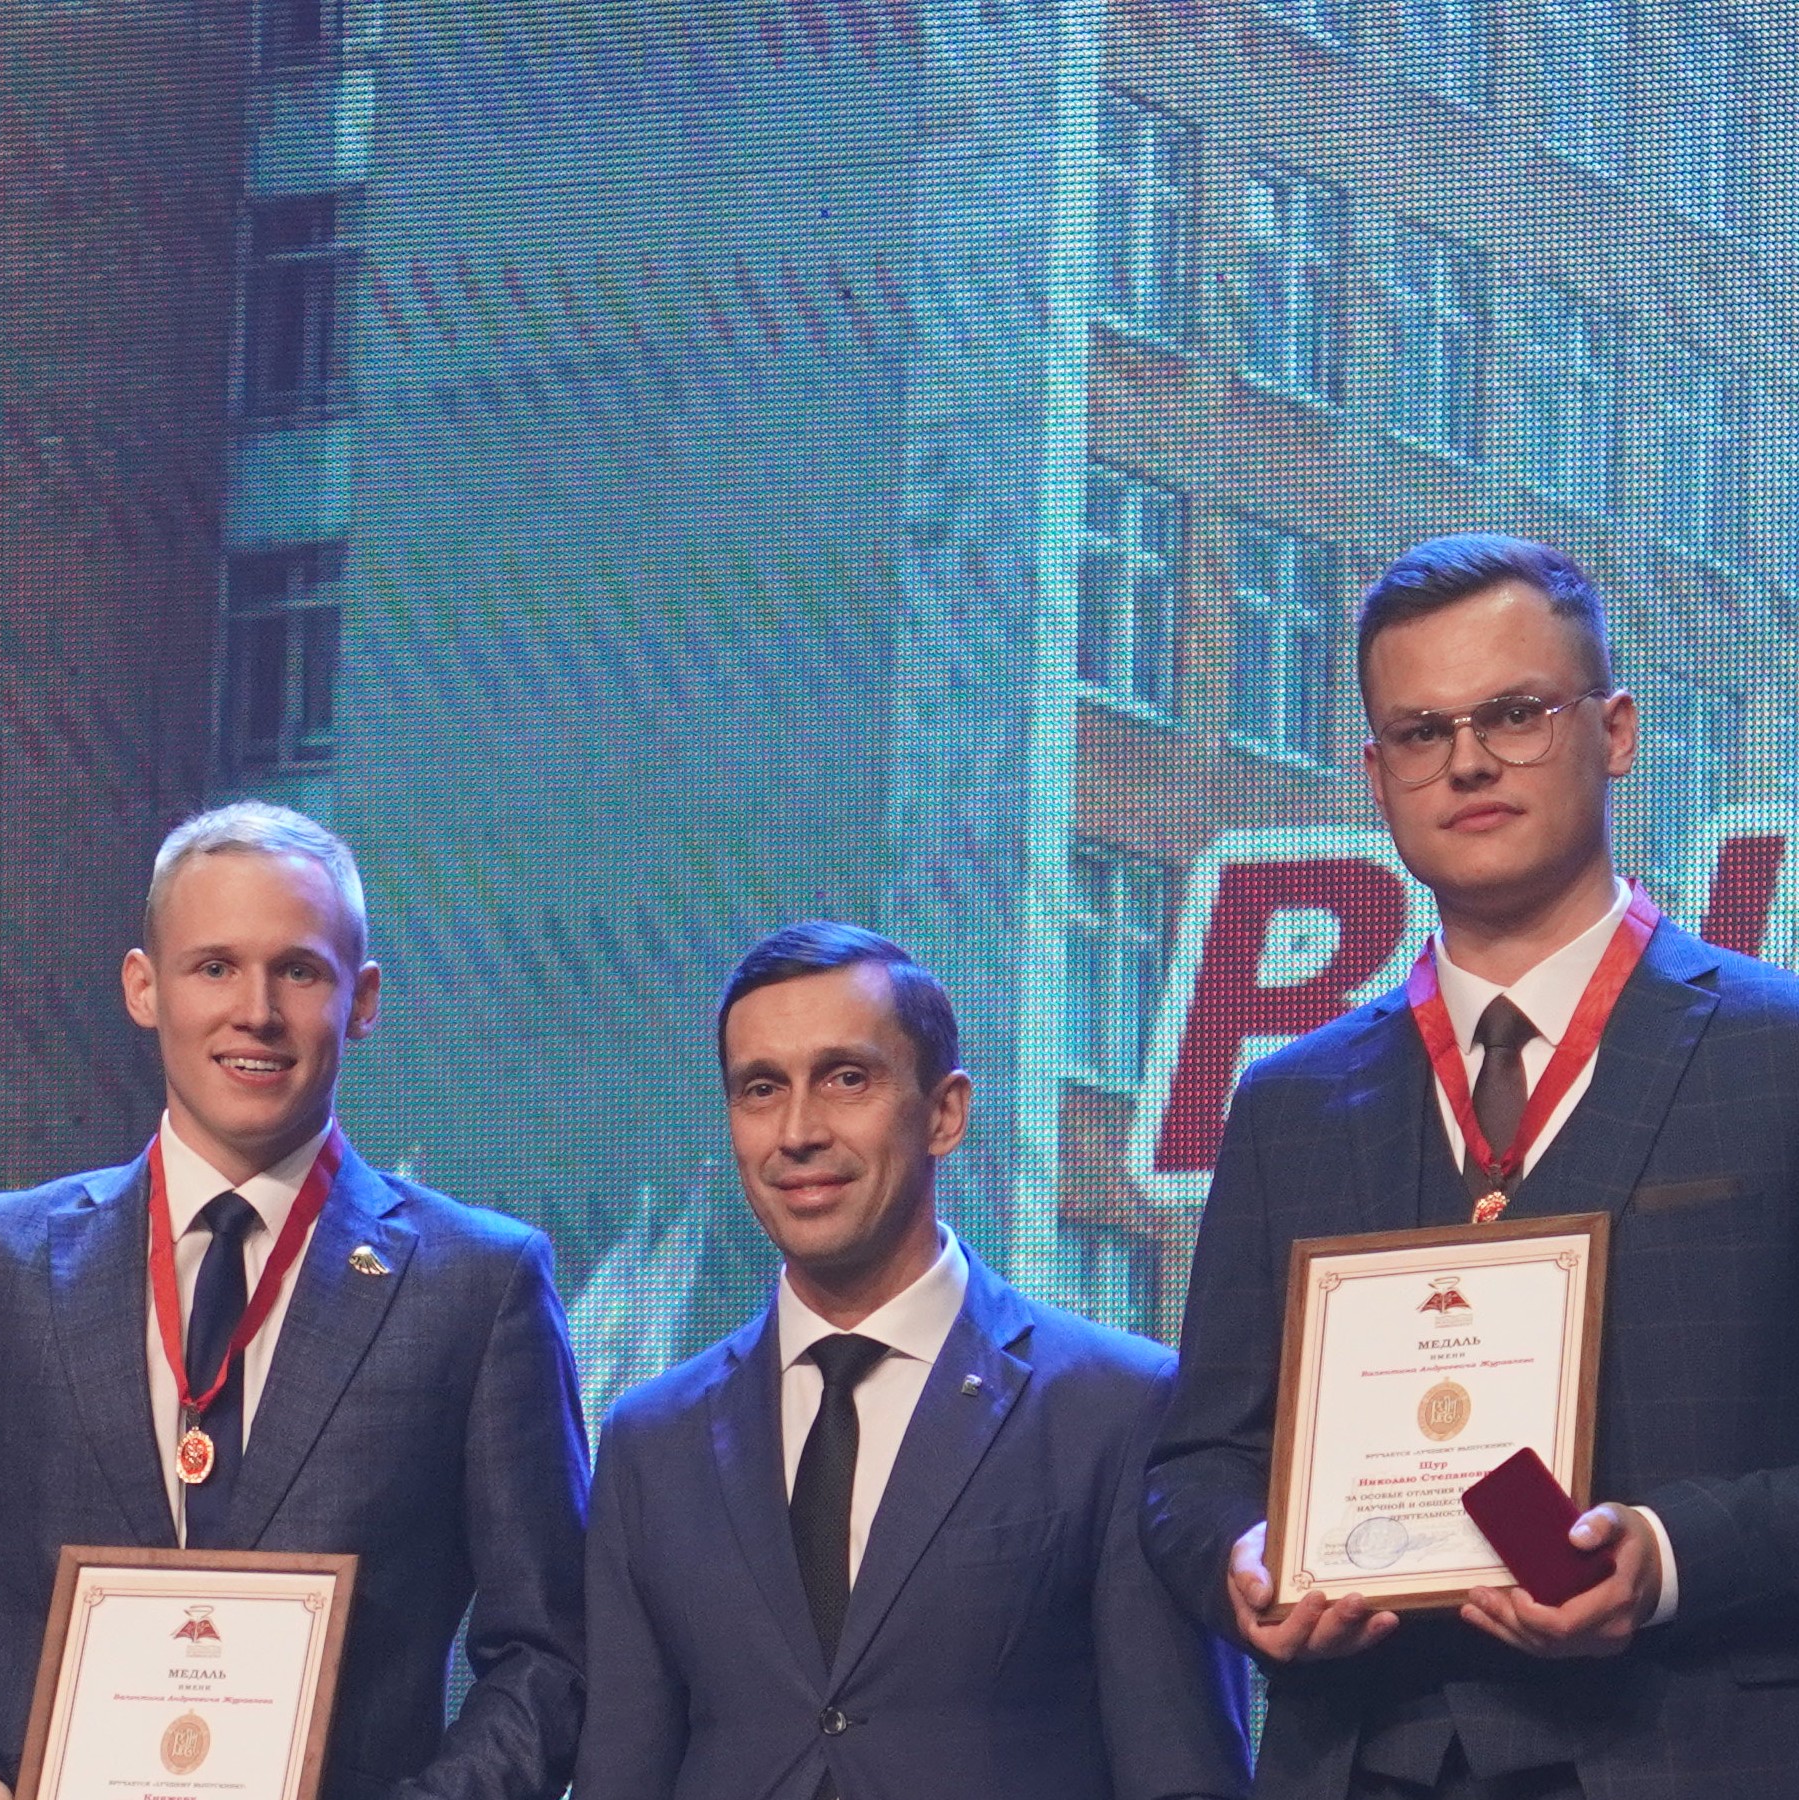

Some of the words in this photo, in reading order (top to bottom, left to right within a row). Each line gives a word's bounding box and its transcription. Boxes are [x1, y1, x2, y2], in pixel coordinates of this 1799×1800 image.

[1418, 1336, 1481, 1350] МЕДАЛЬ
[1418, 1461, 1448, 1471] Щур
[1359, 1476, 1417, 1487] Николаю
[1345, 1495, 1357, 1503] ЗА
[1360, 1491, 1403, 1501] ОСОБЫЕ
[1406, 1487, 1455, 1497] ОТЛИЧИЯ
[1357, 1502, 1406, 1513] НАУЧНОЙ
[168, 1669, 227, 1680] МЕДАЛЬ
